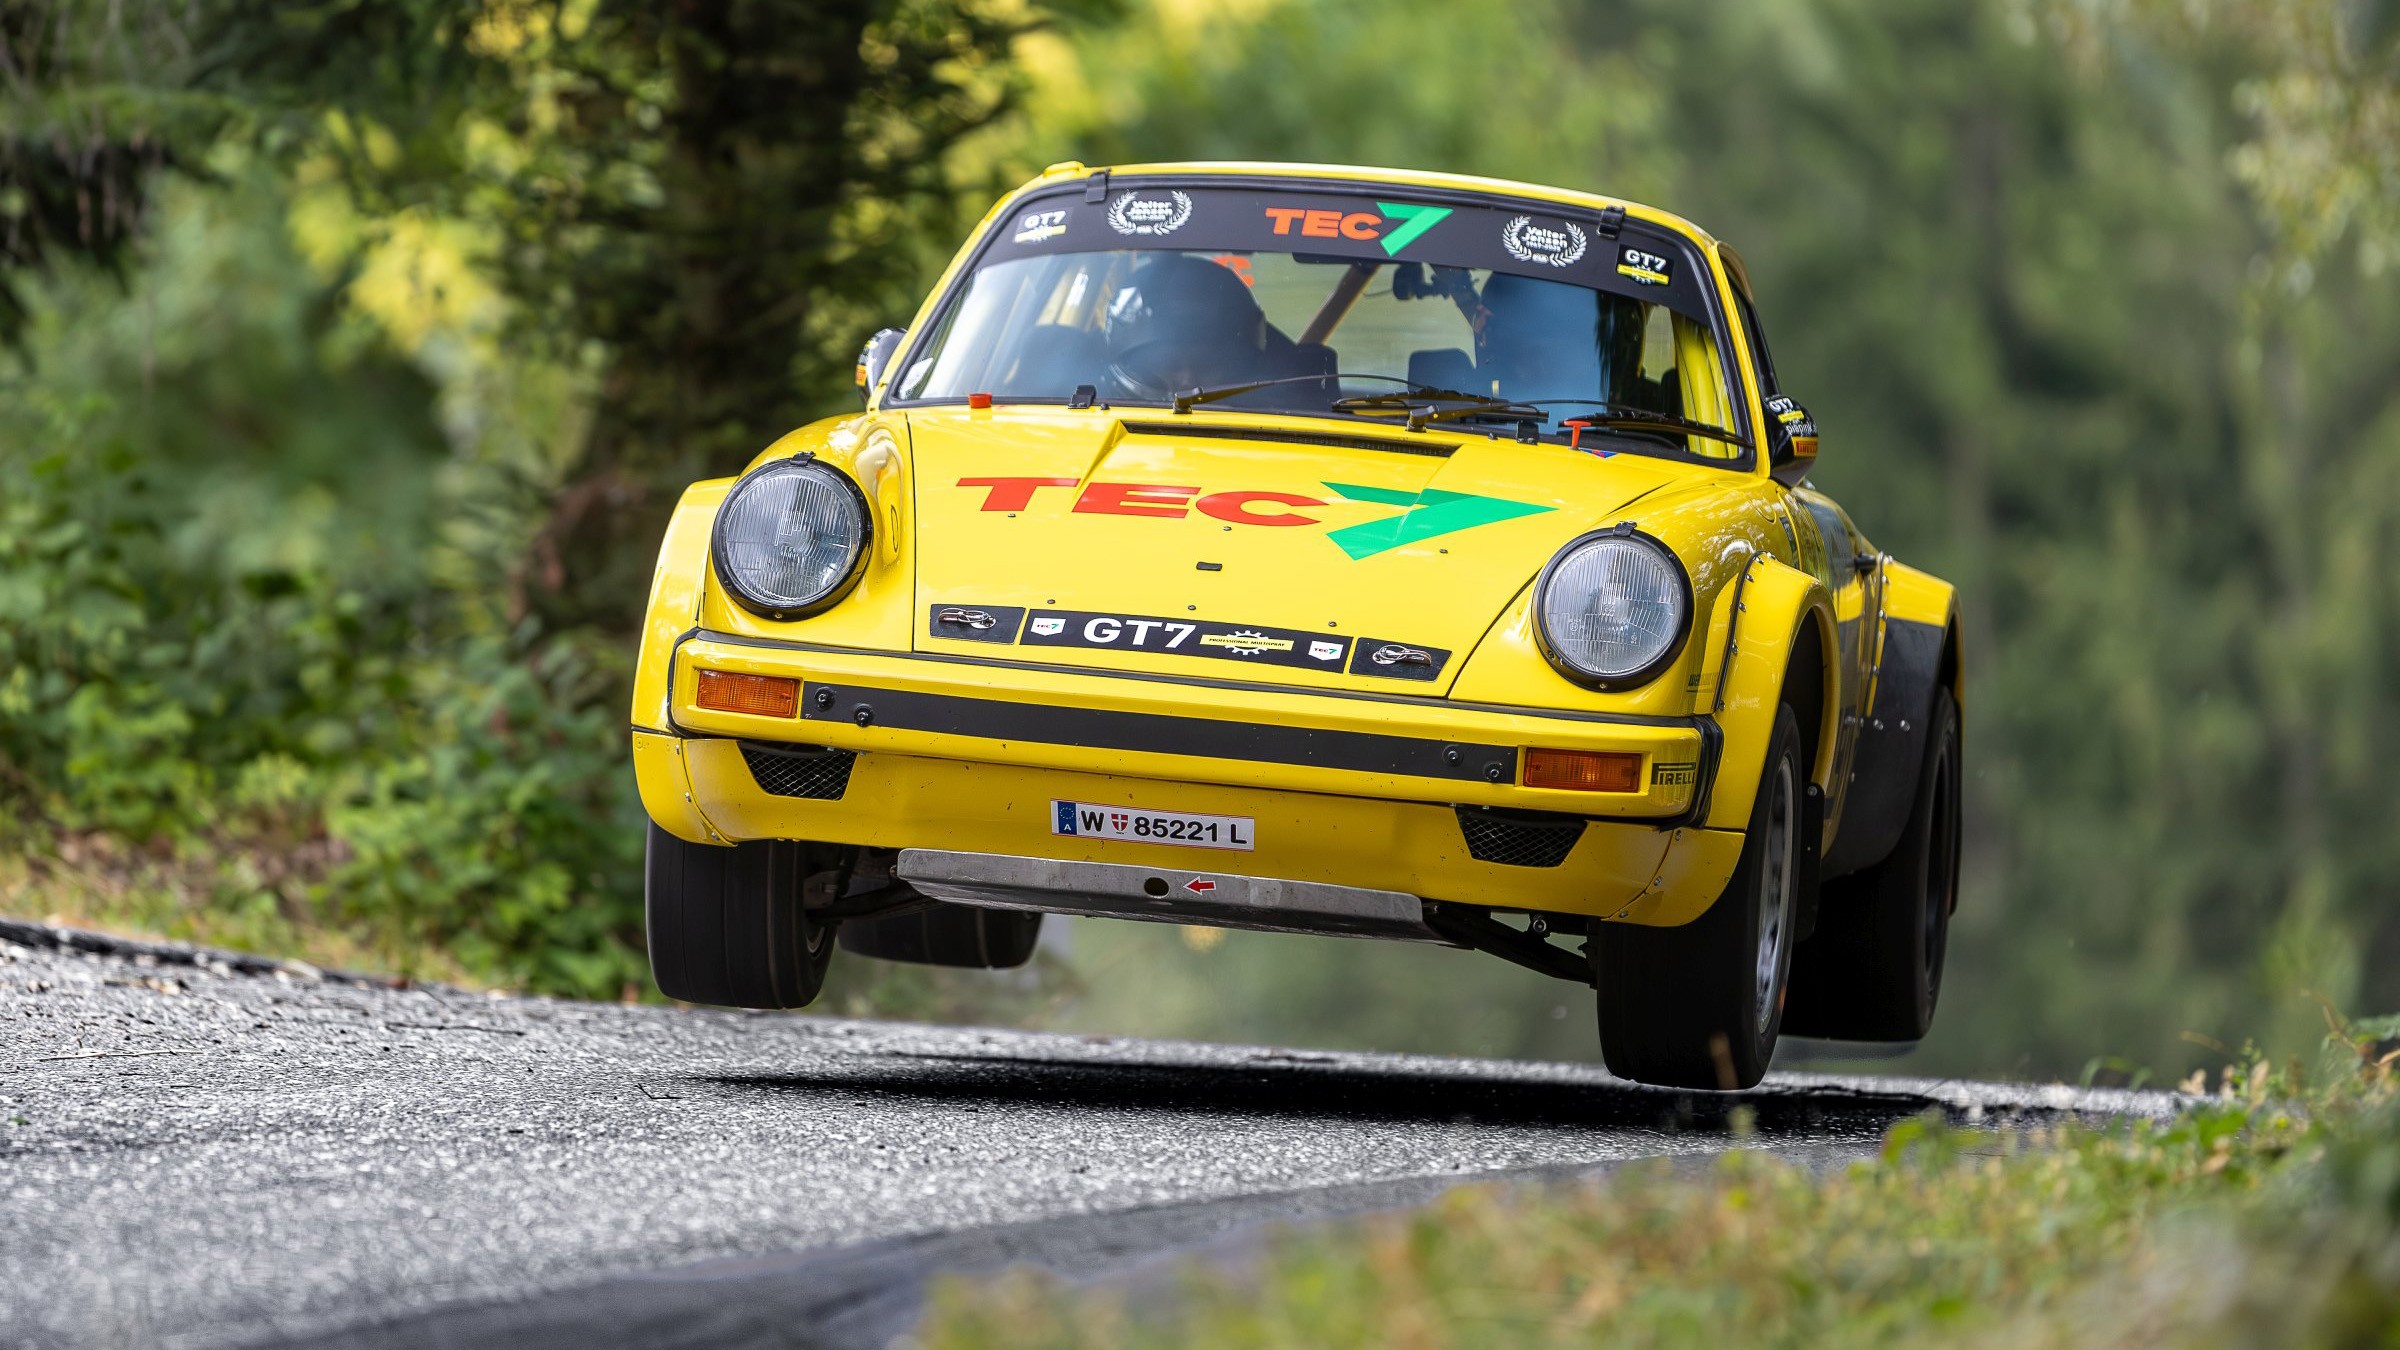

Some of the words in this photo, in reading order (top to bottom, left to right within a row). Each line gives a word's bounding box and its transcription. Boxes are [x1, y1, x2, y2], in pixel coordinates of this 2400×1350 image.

[1024, 210, 1067, 229] GT7
[1265, 201, 1454, 257] TEC7
[1625, 249, 1667, 272] GT7
[1769, 398, 1793, 412] GT7
[956, 477, 1559, 561] TEC7
[1037, 622, 1059, 630] TEC7
[1083, 617, 1197, 649] GT7
[1314, 647, 1338, 655] TEC7
[1651, 762, 1696, 785] PIRELLI
[1063, 823, 1072, 831] A
[1081, 810, 1105, 832] W
[1134, 816, 1218, 842] 85221
[1230, 823, 1248, 844] L
